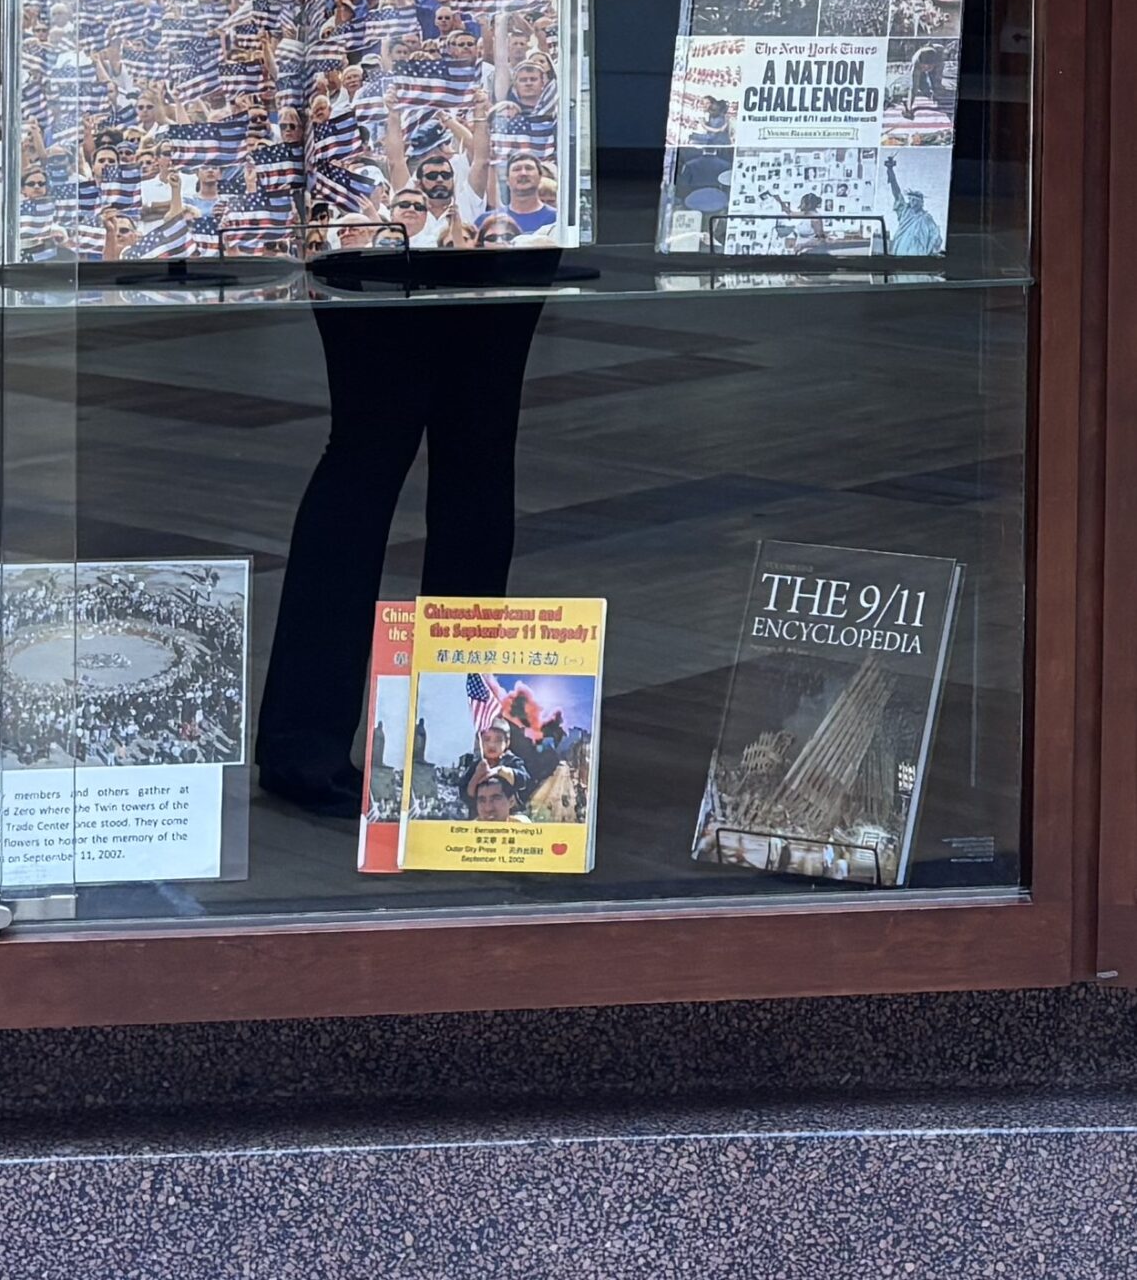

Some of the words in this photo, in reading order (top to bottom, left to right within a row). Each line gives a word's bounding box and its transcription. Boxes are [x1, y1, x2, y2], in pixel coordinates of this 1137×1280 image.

[755, 41, 778, 56] The
[779, 42, 806, 56] New
[807, 42, 841, 58] York
[840, 42, 878, 56] Times
[762, 60, 776, 85] A
[784, 60, 865, 86] NATION
[743, 86, 880, 113] CHALLENGED
[761, 572, 851, 619] THE
[855, 583, 926, 628] 9/11
[538, 605, 563, 622] and
[388, 627, 408, 641] the
[429, 622, 450, 639] the
[452, 623, 521, 642] September
[522, 624, 536, 639] 11
[540, 624, 589, 643] Tragedy
[751, 616, 922, 655] ENCYCLOPEDIA
[14, 789, 61, 800] members
[97, 787, 130, 797] others
[138, 785, 171, 798] gather
[179, 785, 190, 795] at
[13, 806, 36, 816] Zero
[39, 804, 71, 815] where
[72, 803, 91, 814] the
[94, 802, 118, 813] Twin
[121, 802, 156, 812] towers
[158, 801, 170, 810] of
[172, 800, 190, 810] the
[6, 822, 34, 832] Trade
[37, 820, 70, 831] Center
[75, 821, 98, 830] once
[100, 818, 132, 829] stood.
[134, 816, 159, 829] They
[161, 817, 189, 826] come
[4, 837, 40, 848] flowers
[43, 837, 55, 847] to
[91, 834, 109, 844] the
[111, 834, 154, 846] memory
[157, 831, 169, 842] of
[171, 831, 188, 841] the
[8, 855, 21, 863] on
[80, 851, 96, 862] 11,
[98, 849, 126, 860] 2002.
